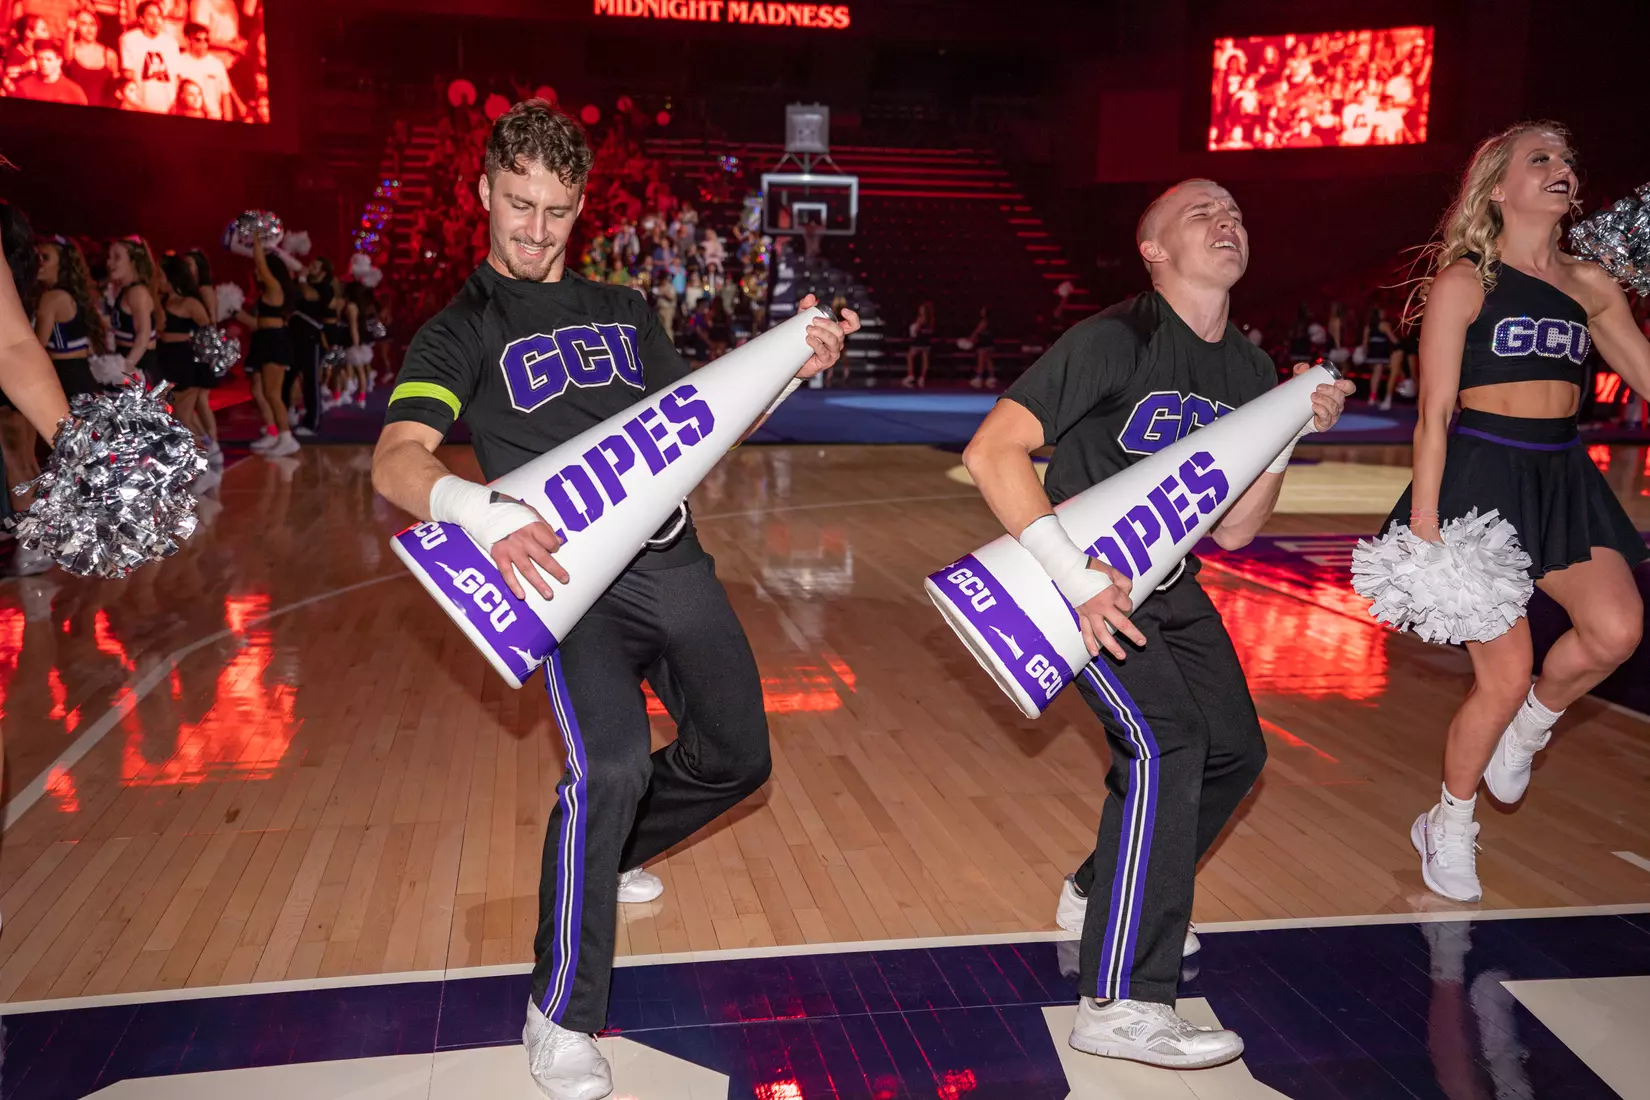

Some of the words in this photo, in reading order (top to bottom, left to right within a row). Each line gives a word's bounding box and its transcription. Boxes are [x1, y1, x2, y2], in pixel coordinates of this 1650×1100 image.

[594, 0, 723, 21] MIDNIGHT
[728, 2, 850, 29] MADNESS
[1492, 317, 1591, 365] GCU
[500, 322, 645, 413] GCU
[1117, 388, 1236, 455] GC
[523, 384, 715, 546] OPES
[411, 521, 448, 551] CU
[452, 567, 517, 633] GCU
[947, 568, 997, 613] GCU
[1025, 654, 1063, 700] GCU
